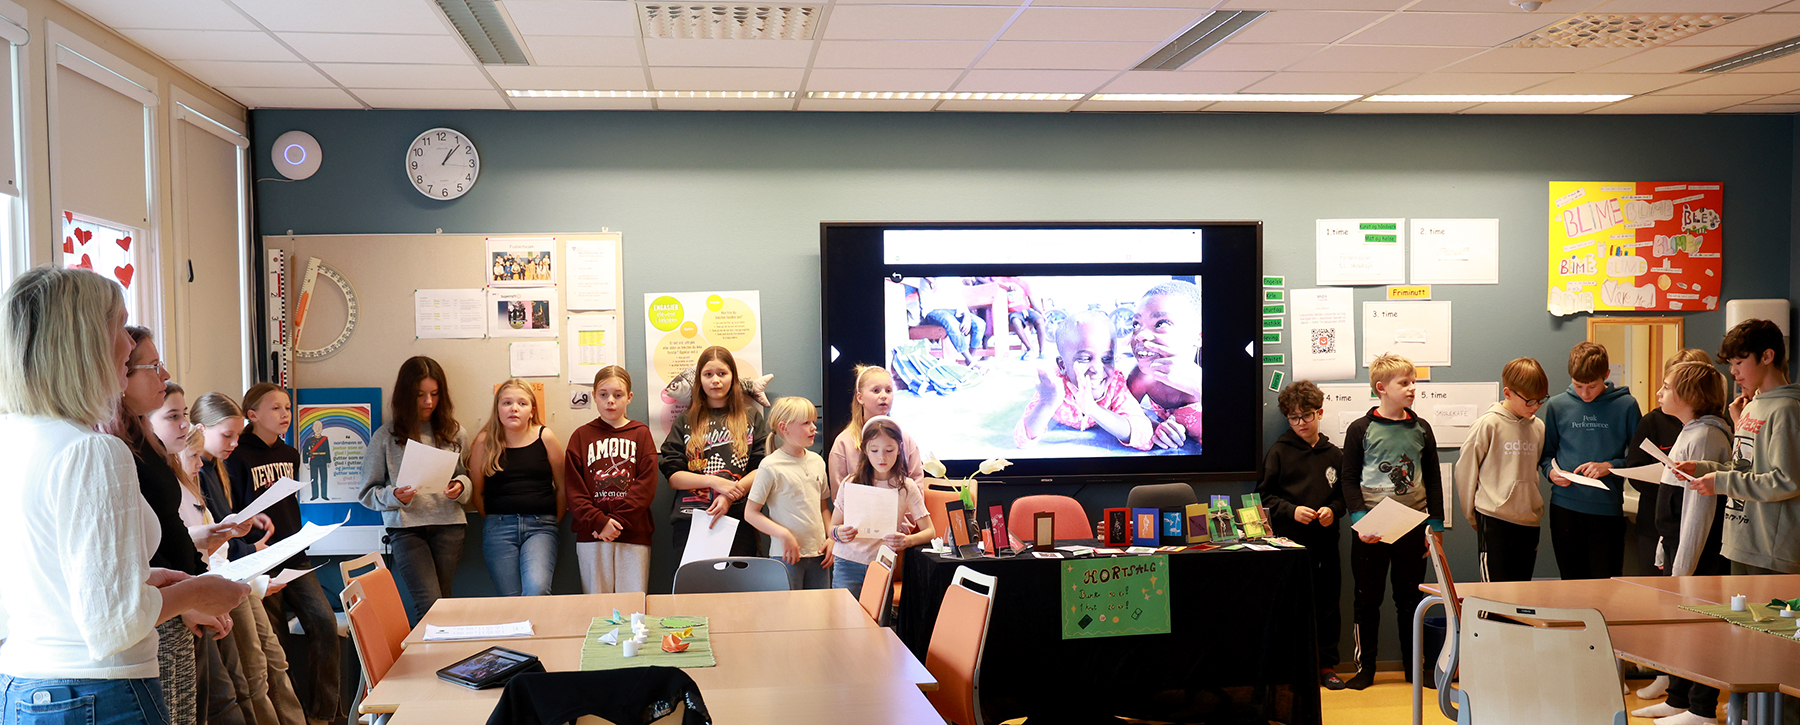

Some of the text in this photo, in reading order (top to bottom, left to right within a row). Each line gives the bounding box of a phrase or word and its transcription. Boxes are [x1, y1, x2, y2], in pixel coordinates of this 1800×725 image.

[436, 132, 446, 141] 12
[455, 136, 459, 144] 1
[422, 137, 430, 146] 11
[413, 148, 423, 157] 10
[465, 146, 472, 154] 2
[412, 161, 418, 170] 9
[468, 159, 475, 168] 3
[416, 175, 423, 184] 8
[465, 173, 471, 181] 4
[427, 185, 433, 193] 7
[456, 183, 463, 192] 5
[442, 188, 448, 197] 6
[1564, 198, 1624, 238] BLIME
[1504, 440, 1537, 450] adidas
[1083, 562, 1156, 584] KORTSALG
